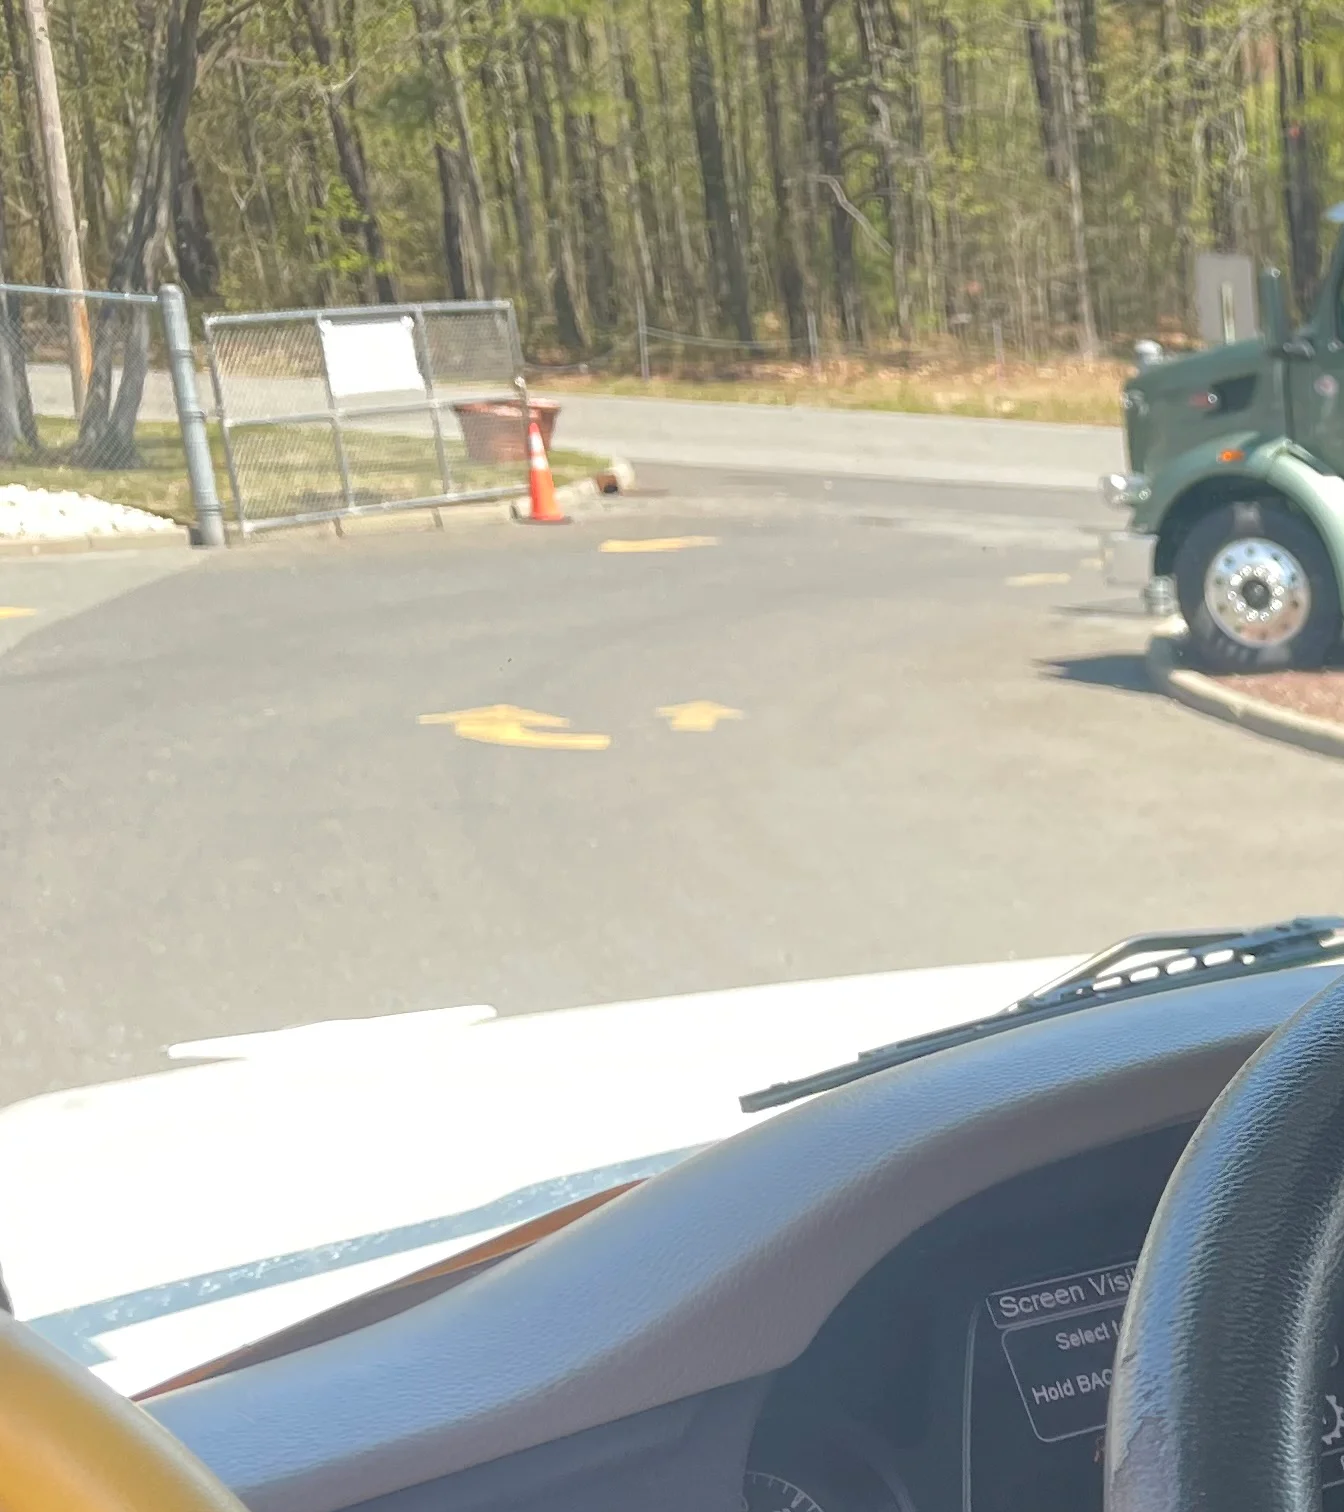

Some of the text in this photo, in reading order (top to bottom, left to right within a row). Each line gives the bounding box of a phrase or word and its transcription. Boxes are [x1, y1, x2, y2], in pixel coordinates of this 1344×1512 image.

[999, 1284, 1086, 1318] Screen
[1055, 1322, 1110, 1350] Select
[1032, 1378, 1075, 1405] Hold
